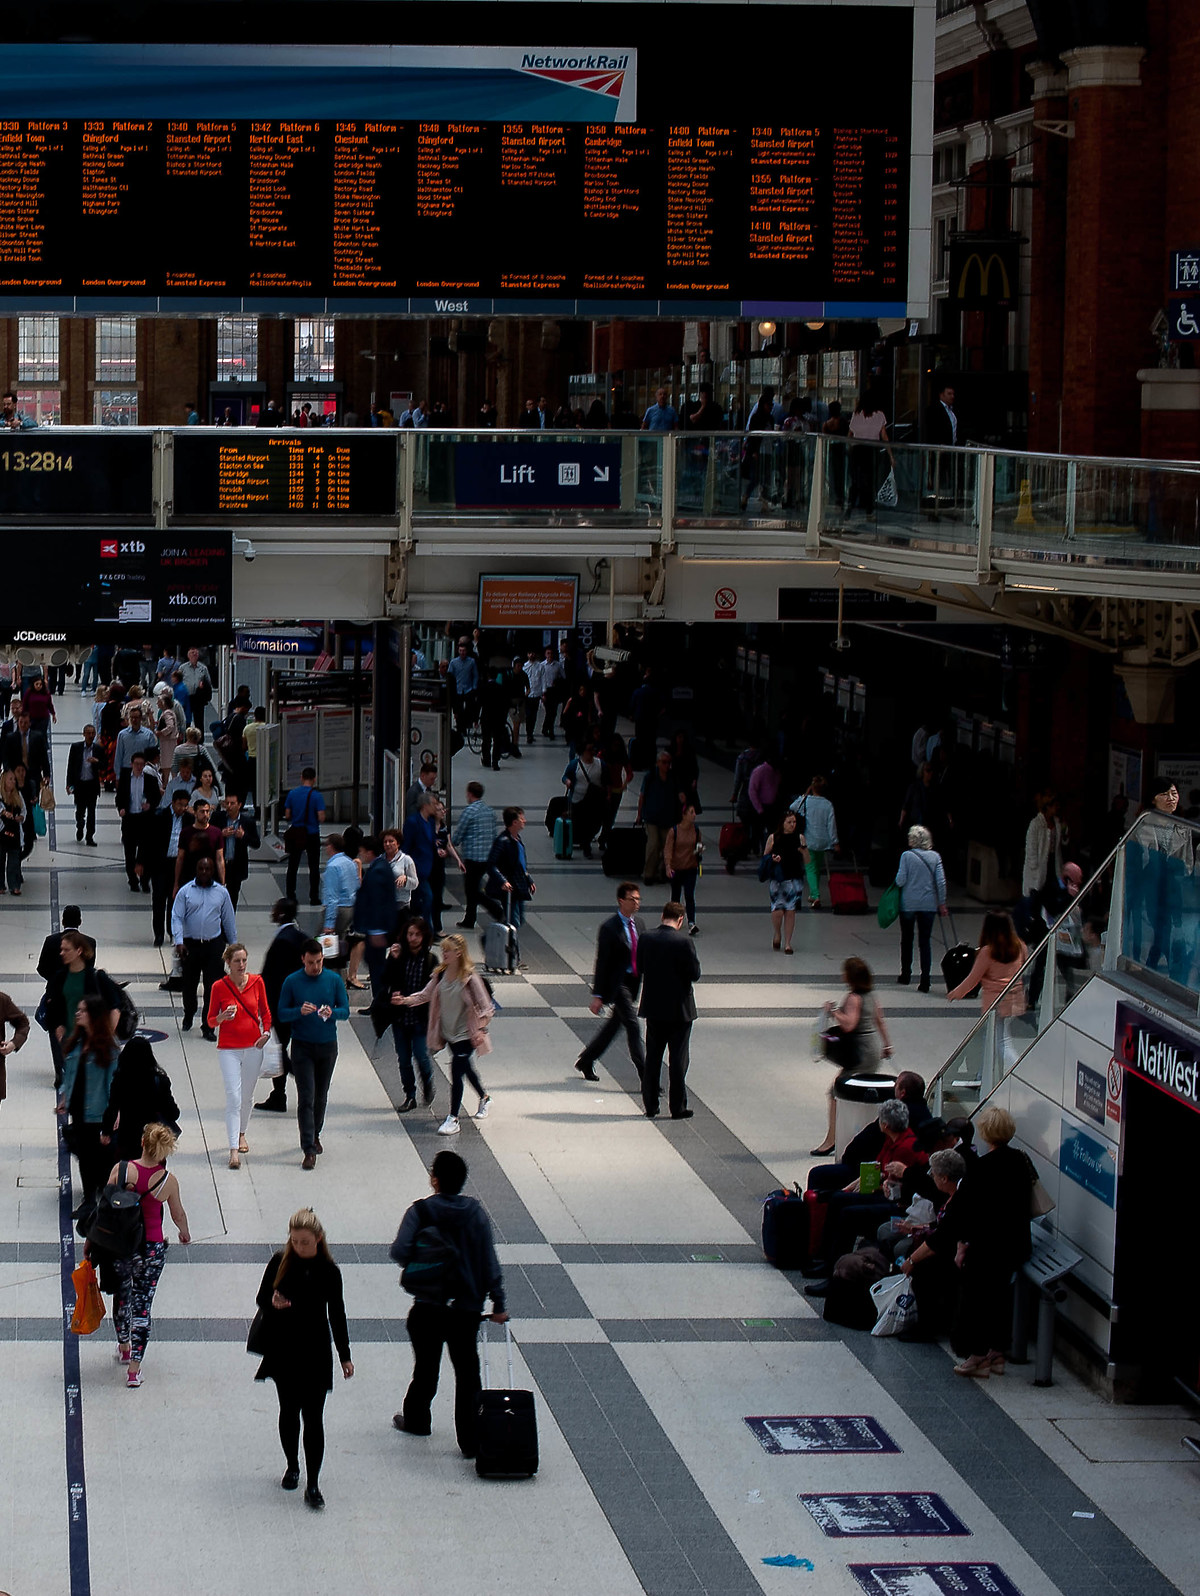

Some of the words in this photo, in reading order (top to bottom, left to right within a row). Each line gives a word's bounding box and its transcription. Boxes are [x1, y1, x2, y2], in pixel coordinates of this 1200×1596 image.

[521, 54, 629, 69] NetworkRail
[28, 122, 60, 130] Platform
[113, 122, 144, 130] Platform
[197, 123, 228, 131] Platform
[280, 123, 311, 131] Platform
[365, 124, 396, 132] Platform
[448, 124, 479, 132] Platform
[532, 125, 563, 133] Platform
[615, 126, 646, 134] Platform
[698, 127, 729, 135] Platform
[781, 128, 812, 136] Platform
[780, 175, 811, 183] Platform
[780, 222, 810, 230] Platform
[434, 300, 469, 312] West
[500, 464, 535, 484] Lift
[120, 541, 146, 553] xtb
[161, 549, 180, 557] JOIN
[168, 593, 217, 605] xtb.com
[13, 631, 67, 642] JCDecaux
[242, 637, 299, 652] information
[1137, 1029, 1199, 1102] NatWest
[850, 1417, 877, 1440] Please
[912, 1494, 939, 1519] Please
[936, 1565, 969, 1592] queue
[969, 1565, 1000, 1592] Please
